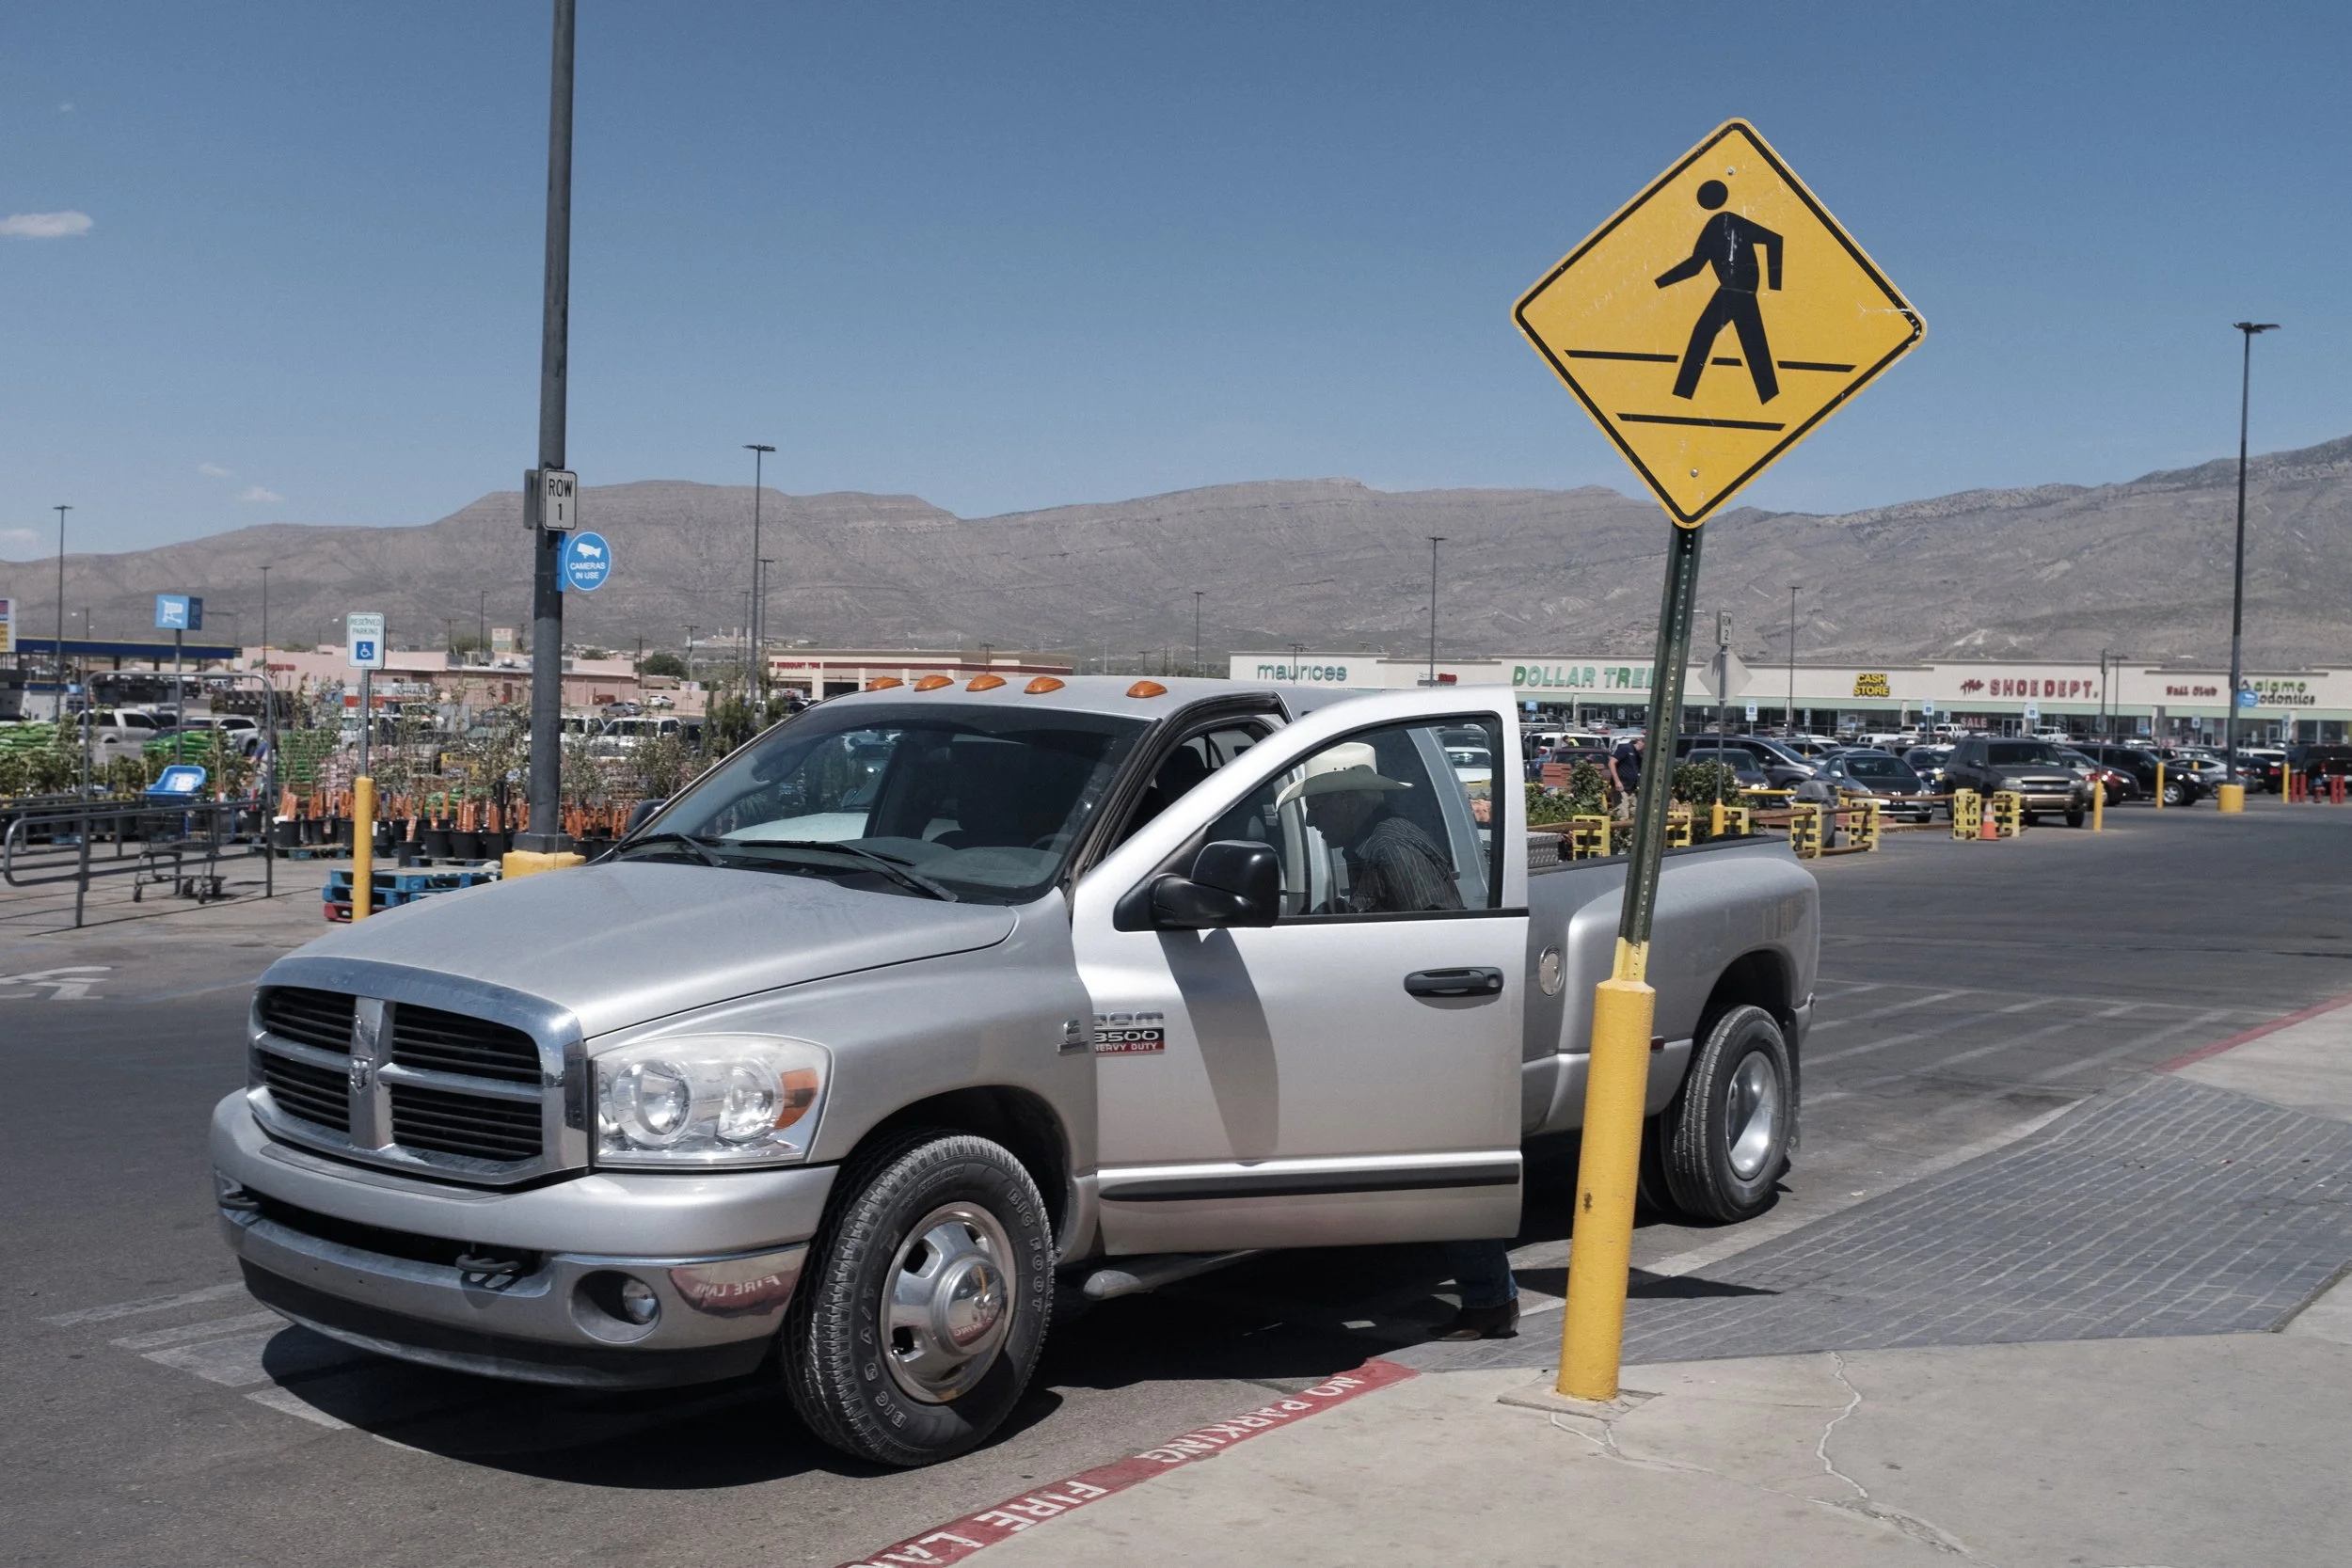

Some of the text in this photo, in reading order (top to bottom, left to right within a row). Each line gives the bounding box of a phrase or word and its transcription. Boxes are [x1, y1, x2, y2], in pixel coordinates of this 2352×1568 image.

[548, 479, 573, 498] ROW
[558, 503, 563, 521] 1
[569, 562, 606, 570] CAMERAS
[349, 618, 381, 626] RESERVED
[1257, 664, 1347, 682] maurices
[1512, 665, 1597, 688] DOLLAR
[1856, 673, 1887, 685] CASH
[1853, 685, 1890, 697] STORE
[1990, 678, 2039, 697] SHOE
[2044, 679, 2099, 699] DEPT.
[2166, 685, 2217, 697] Nail Club
[2259, 691, 2315, 705] odontics
[1960, 717, 1988, 728] SALE
[1094, 1030, 1159, 1042] 3500
[1131, 1041, 1158, 1051] DUTY
[1007, 1188, 1045, 1313] BIG FOOT
[1304, 1376, 1365, 1397] NO
[875, 1390, 907, 1429] BIG
[1133, 1399, 1313, 1463] PARKING
[973, 1480, 1109, 1531] FIRE
